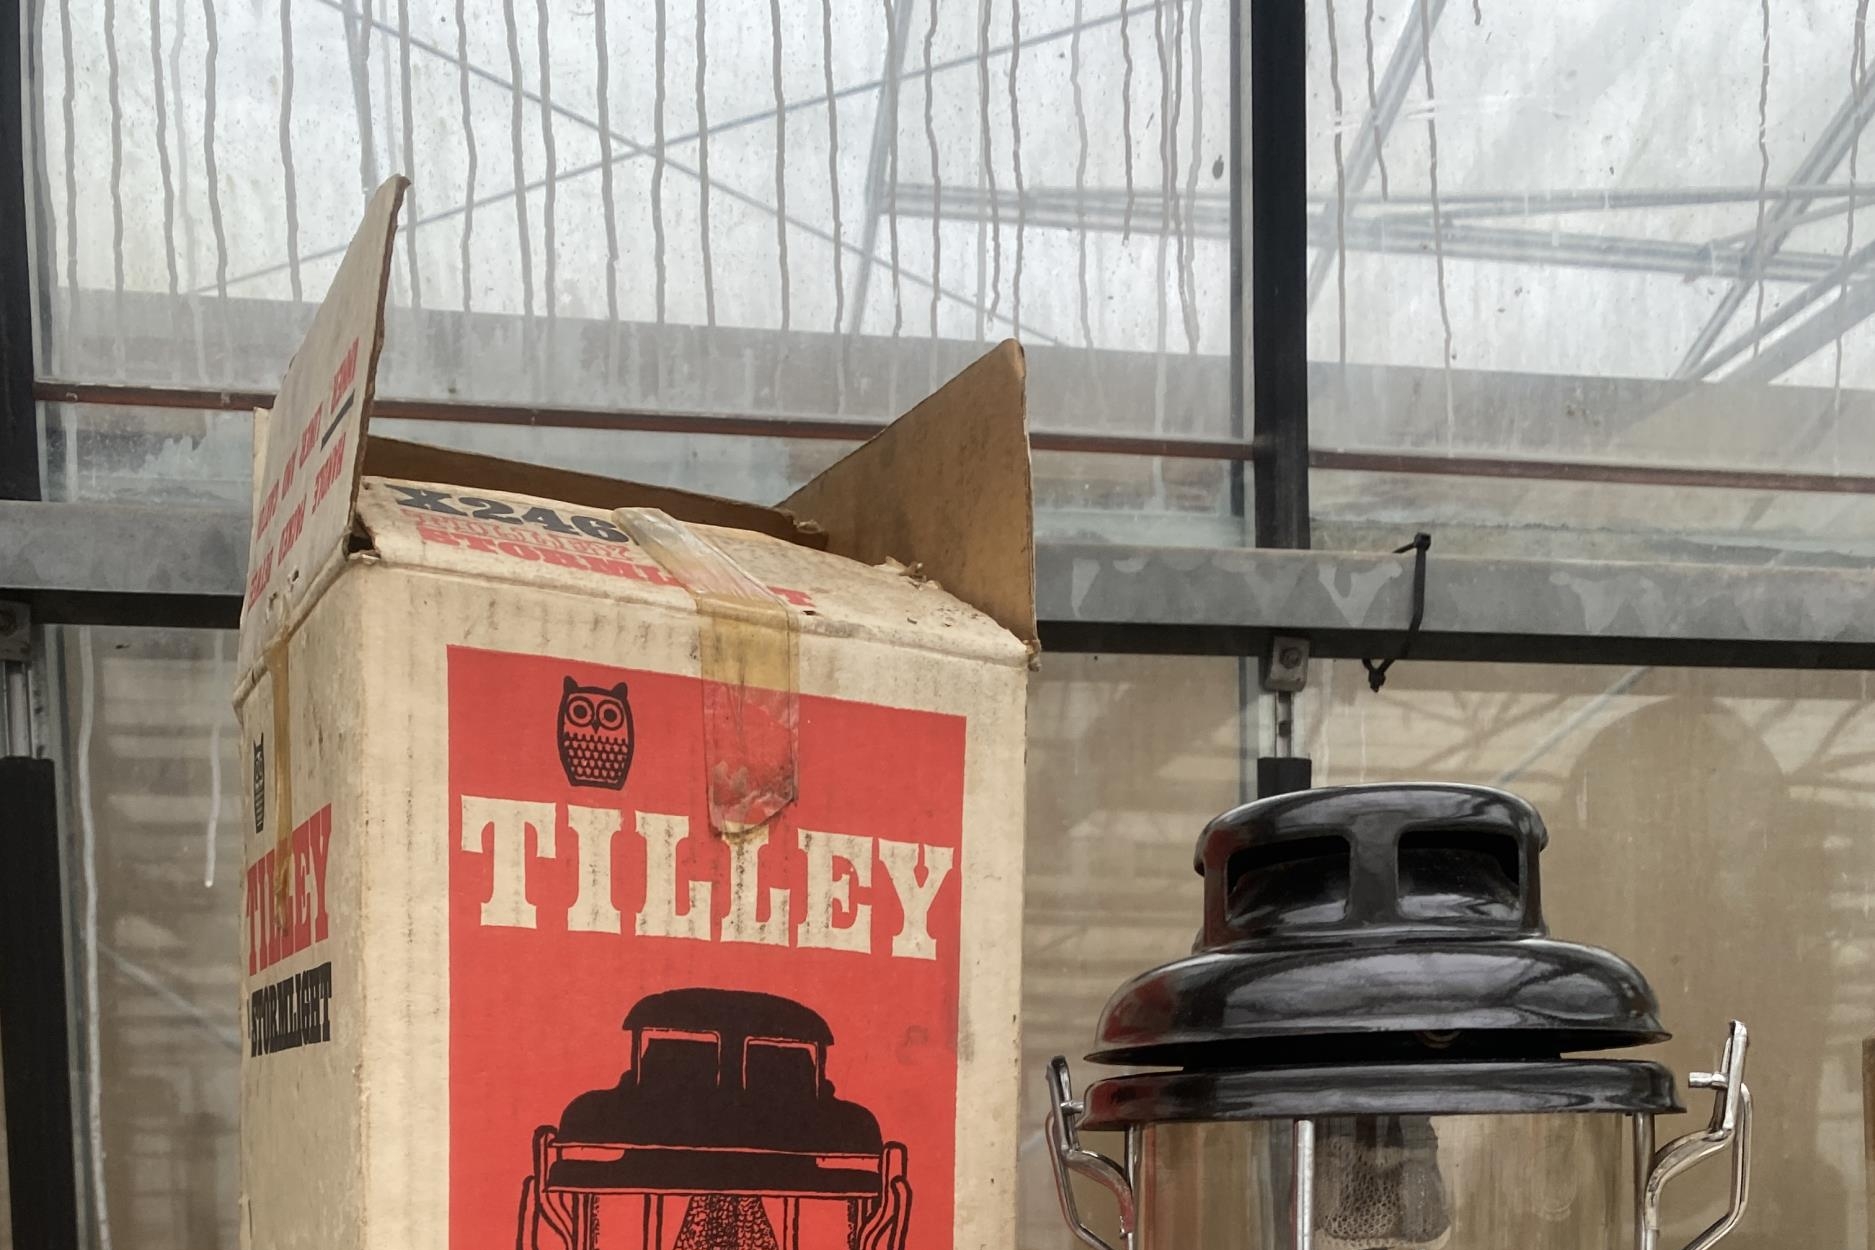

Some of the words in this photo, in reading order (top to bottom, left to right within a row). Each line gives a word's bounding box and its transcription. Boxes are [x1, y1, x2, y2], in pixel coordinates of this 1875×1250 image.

[384, 483, 640, 546] X246
[416, 525, 816, 608] STORMLT
[247, 802, 333, 977] TILLEY
[461, 794, 954, 961] TILLEY
[251, 961, 333, 1058] STORMLIGHT
